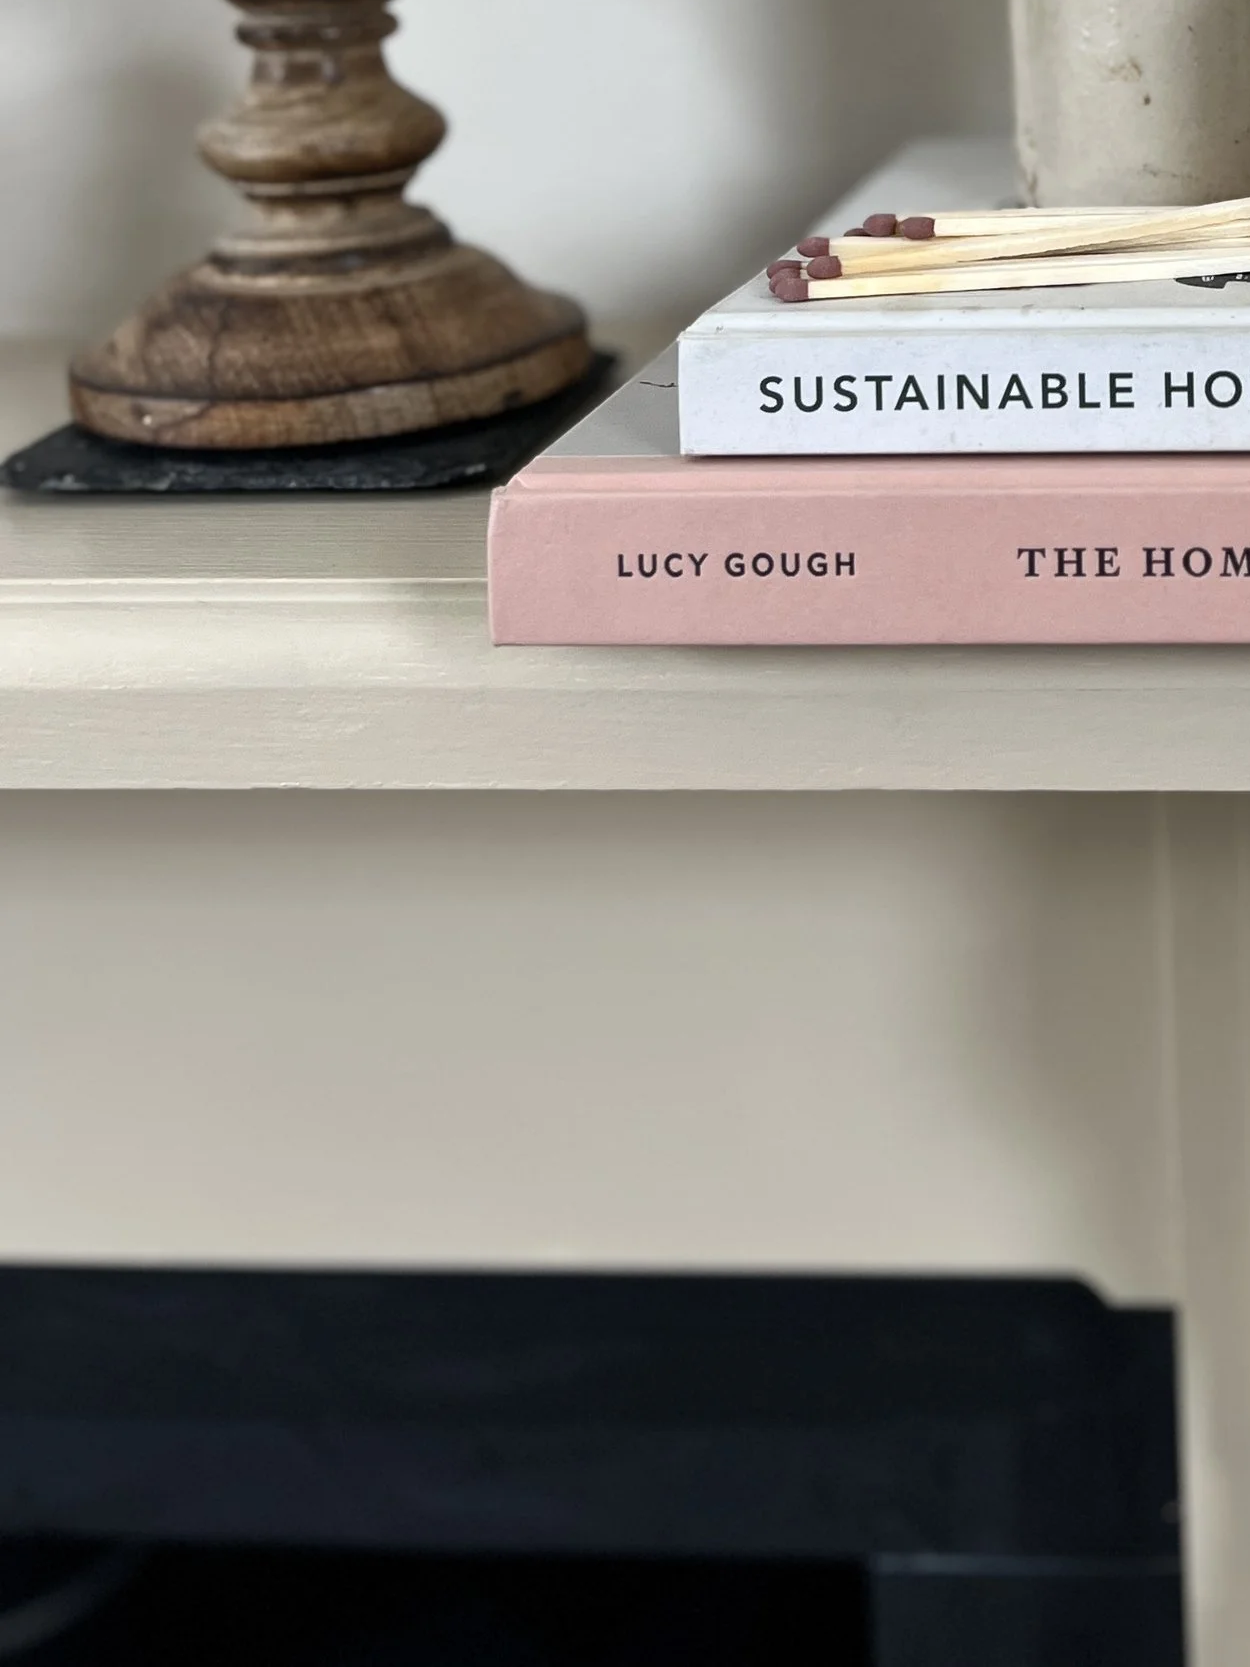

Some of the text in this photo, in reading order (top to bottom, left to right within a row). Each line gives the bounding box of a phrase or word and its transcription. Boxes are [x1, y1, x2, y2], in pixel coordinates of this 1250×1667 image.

[759, 372, 1135, 414] SUSTAINABLE
[617, 552, 855, 578] LUCY GOUGH
[1017, 547, 1121, 578] THE
